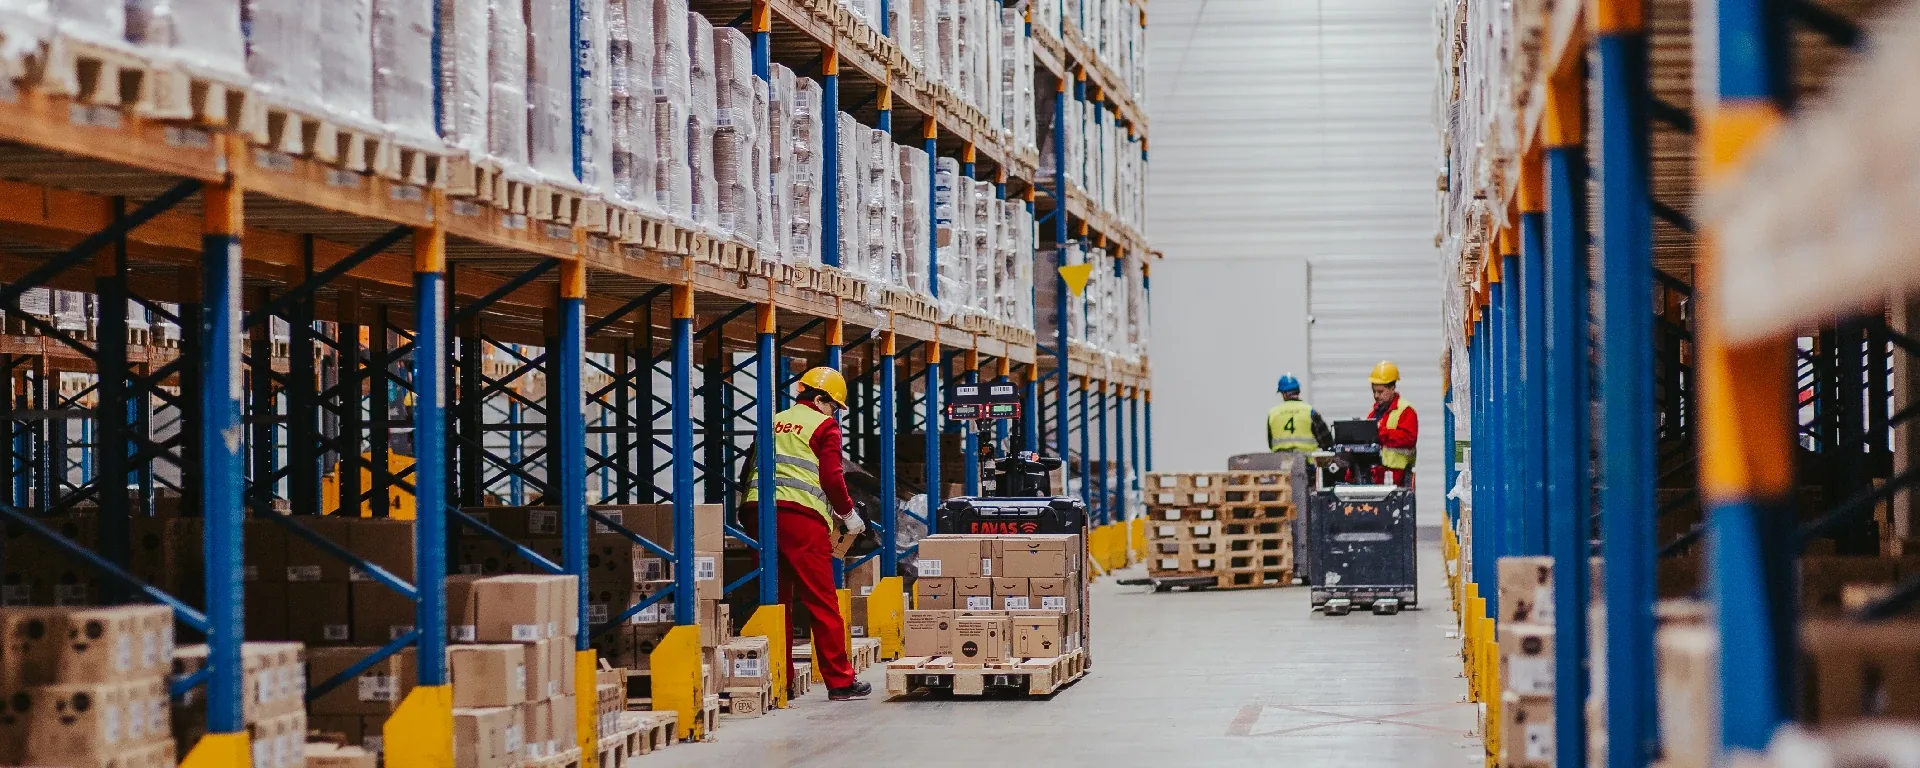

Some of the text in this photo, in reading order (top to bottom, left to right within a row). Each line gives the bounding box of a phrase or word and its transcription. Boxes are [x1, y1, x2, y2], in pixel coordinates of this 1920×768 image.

[775, 421, 803, 435] ben
[1284, 416, 1295, 435] 4
[971, 522, 1018, 534] RAVAS
